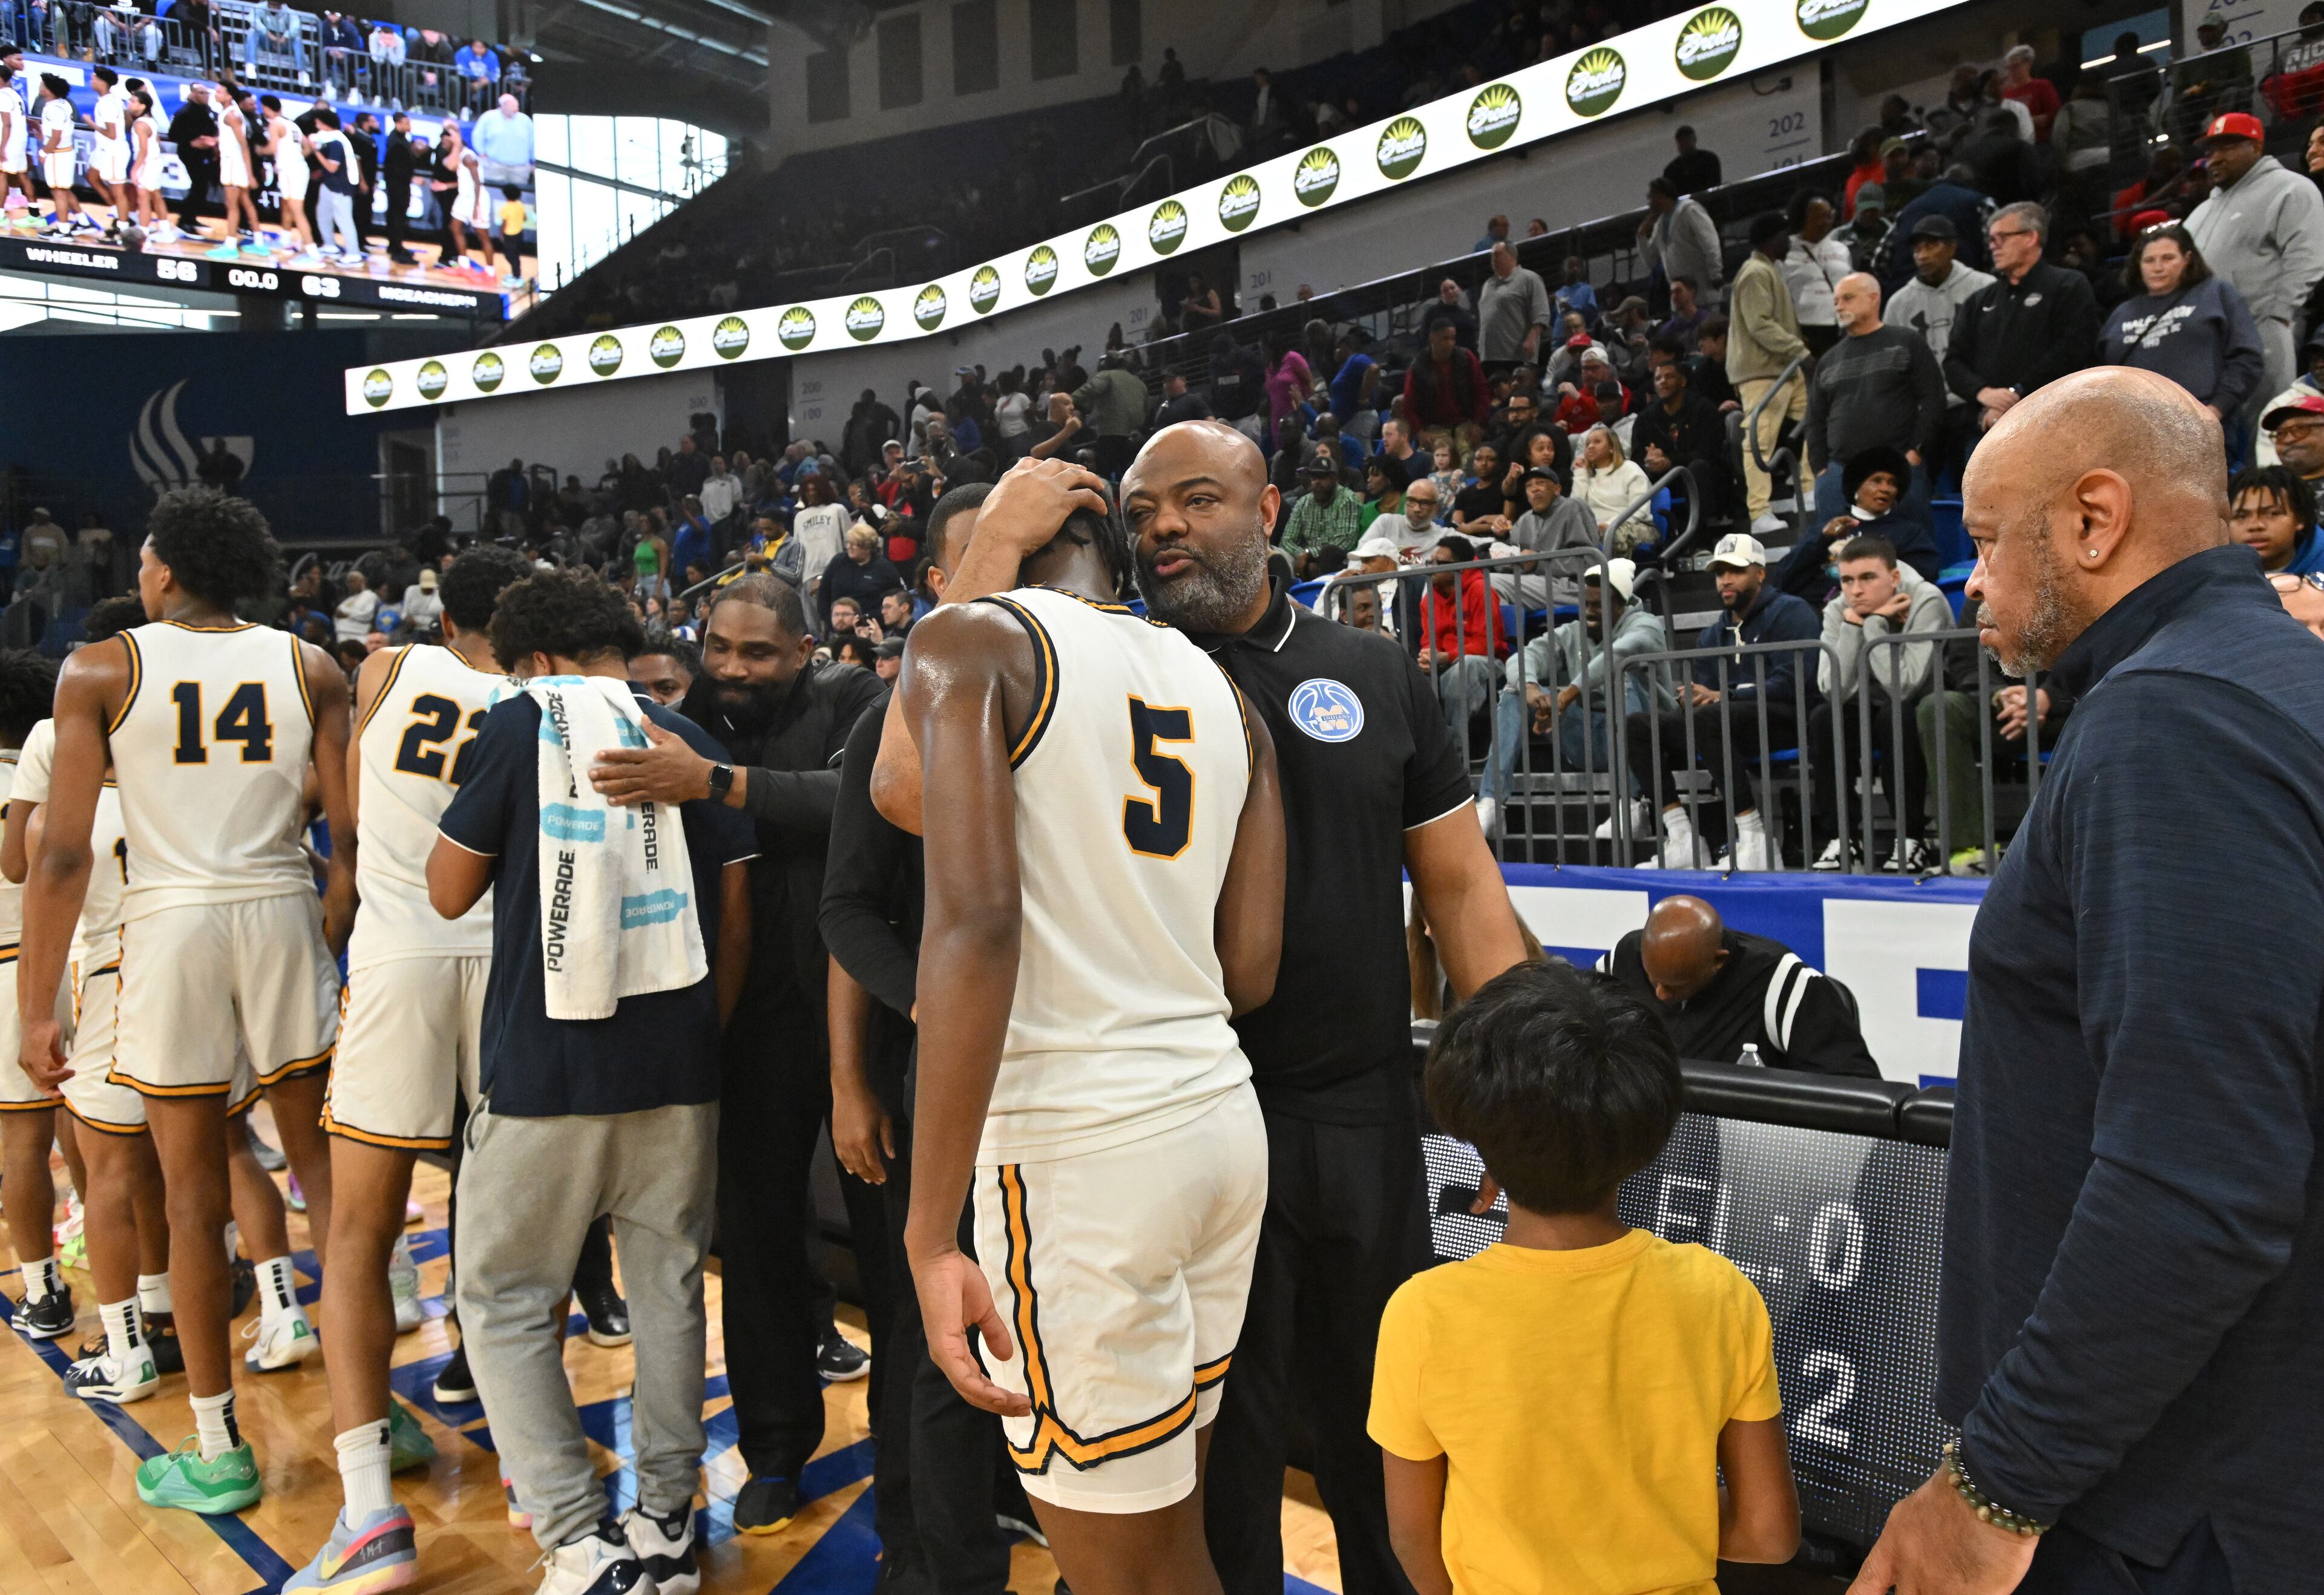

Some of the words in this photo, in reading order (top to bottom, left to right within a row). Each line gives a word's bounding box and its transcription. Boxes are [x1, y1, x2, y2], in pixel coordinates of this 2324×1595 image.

[1768, 111, 1804, 137] 202
[26, 247, 119, 270] WHEELER
[156, 258, 197, 282] 56
[228, 269, 278, 290] 00.0
[302, 275, 341, 298] 63
[1250, 270, 1271, 289] 201
[803, 514, 831, 531] SMILEY
[171, 680, 274, 765] 14
[1121, 692, 1196, 862] 5
[547, 814, 600, 831] POWERADE
[640, 802, 659, 874] ERADE
[625, 901, 675, 918] POWERADE
[1795, 1348, 1856, 1450] 2
